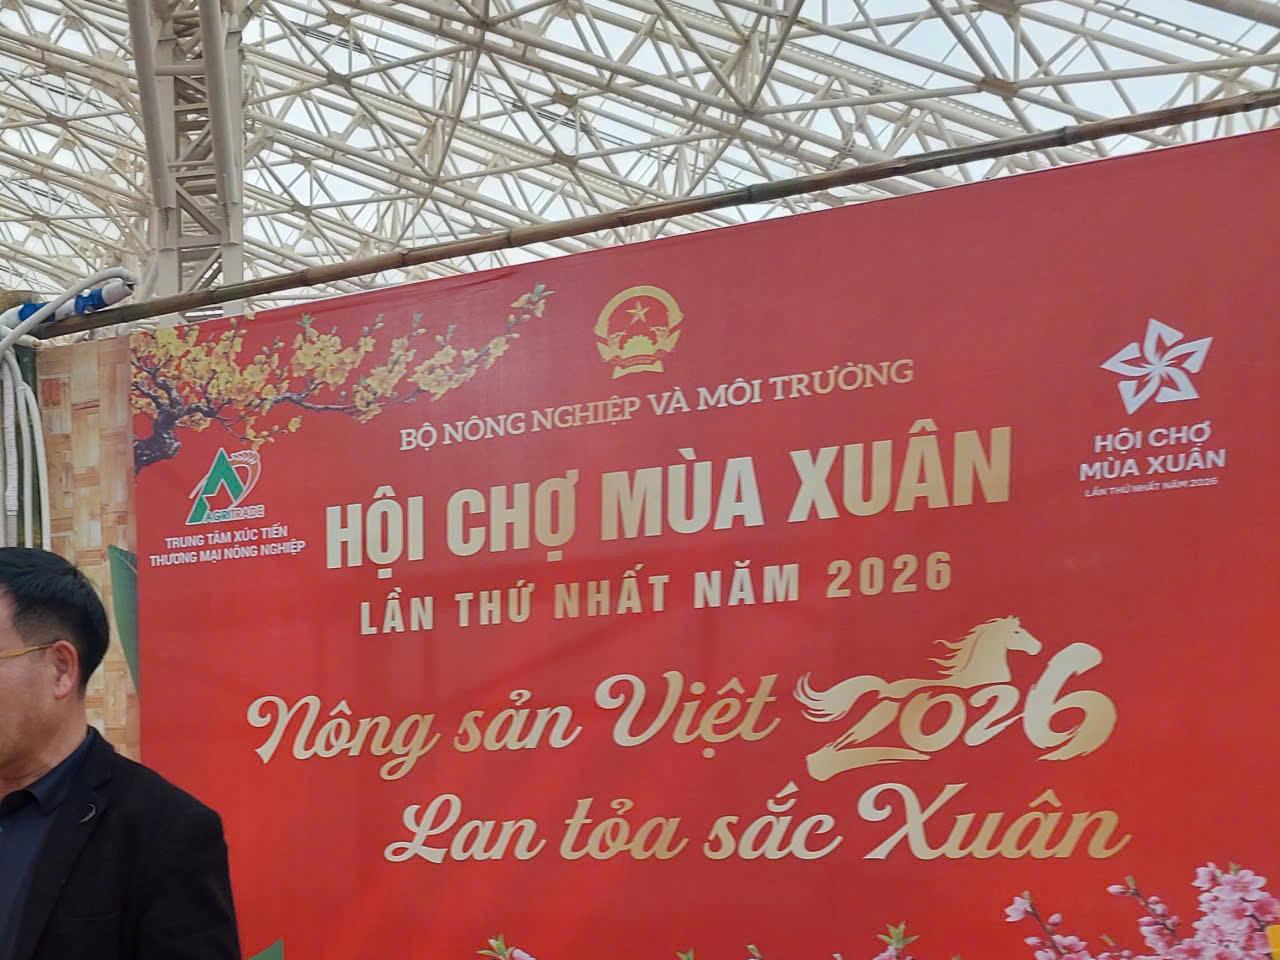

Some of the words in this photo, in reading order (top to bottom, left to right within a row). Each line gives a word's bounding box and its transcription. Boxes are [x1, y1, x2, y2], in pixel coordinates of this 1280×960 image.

[400, 422, 437, 453] BỘ
[443, 412, 526, 447] NÔNG
[531, 394, 641, 432] NGHIỆP
[648, 390, 692, 418] VÀ
[697, 378, 762, 411] MÔI
[768, 358, 915, 404] TRƯỜNG
[1079, 456, 1141, 482] MÙA
[1145, 447, 1227, 476] XUÂN
[1094, 427, 1143, 455] HỘI
[1147, 420, 1212, 447] CHỢ
[205, 504, 265, 523] AGRITRADE
[325, 485, 425, 579] HỘI
[446, 468, 578, 562] CHỢ
[600, 448, 765, 543] MÙA
[788, 418, 1013, 524] XUÂN
[165, 534, 205, 549] TRUNG
[206, 530, 233, 546] TÂM
[233, 526, 259, 543] XÚC
[260, 522, 289, 540] TIẾN
[199, 548, 222, 564] MẠI
[223, 543, 258, 560] NÔNG
[260, 537, 307, 556] NGHIỆP
[359, 587, 435, 637] LẦN
[455, 580, 536, 629] THỨ
[553, 562, 671, 622] NHẤT
[692, 559, 801, 610] NĂM
[824, 550, 953, 601] 2026
[246, 693, 443, 782] Nông
[453, 689, 584, 755] sản
[593, 670, 784, 761] Việt
[383, 792, 549, 865] Lan
[558, 797, 689, 863] tỏa
[702, 782, 844, 863] sắc
[856, 781, 1134, 864] Xuân
